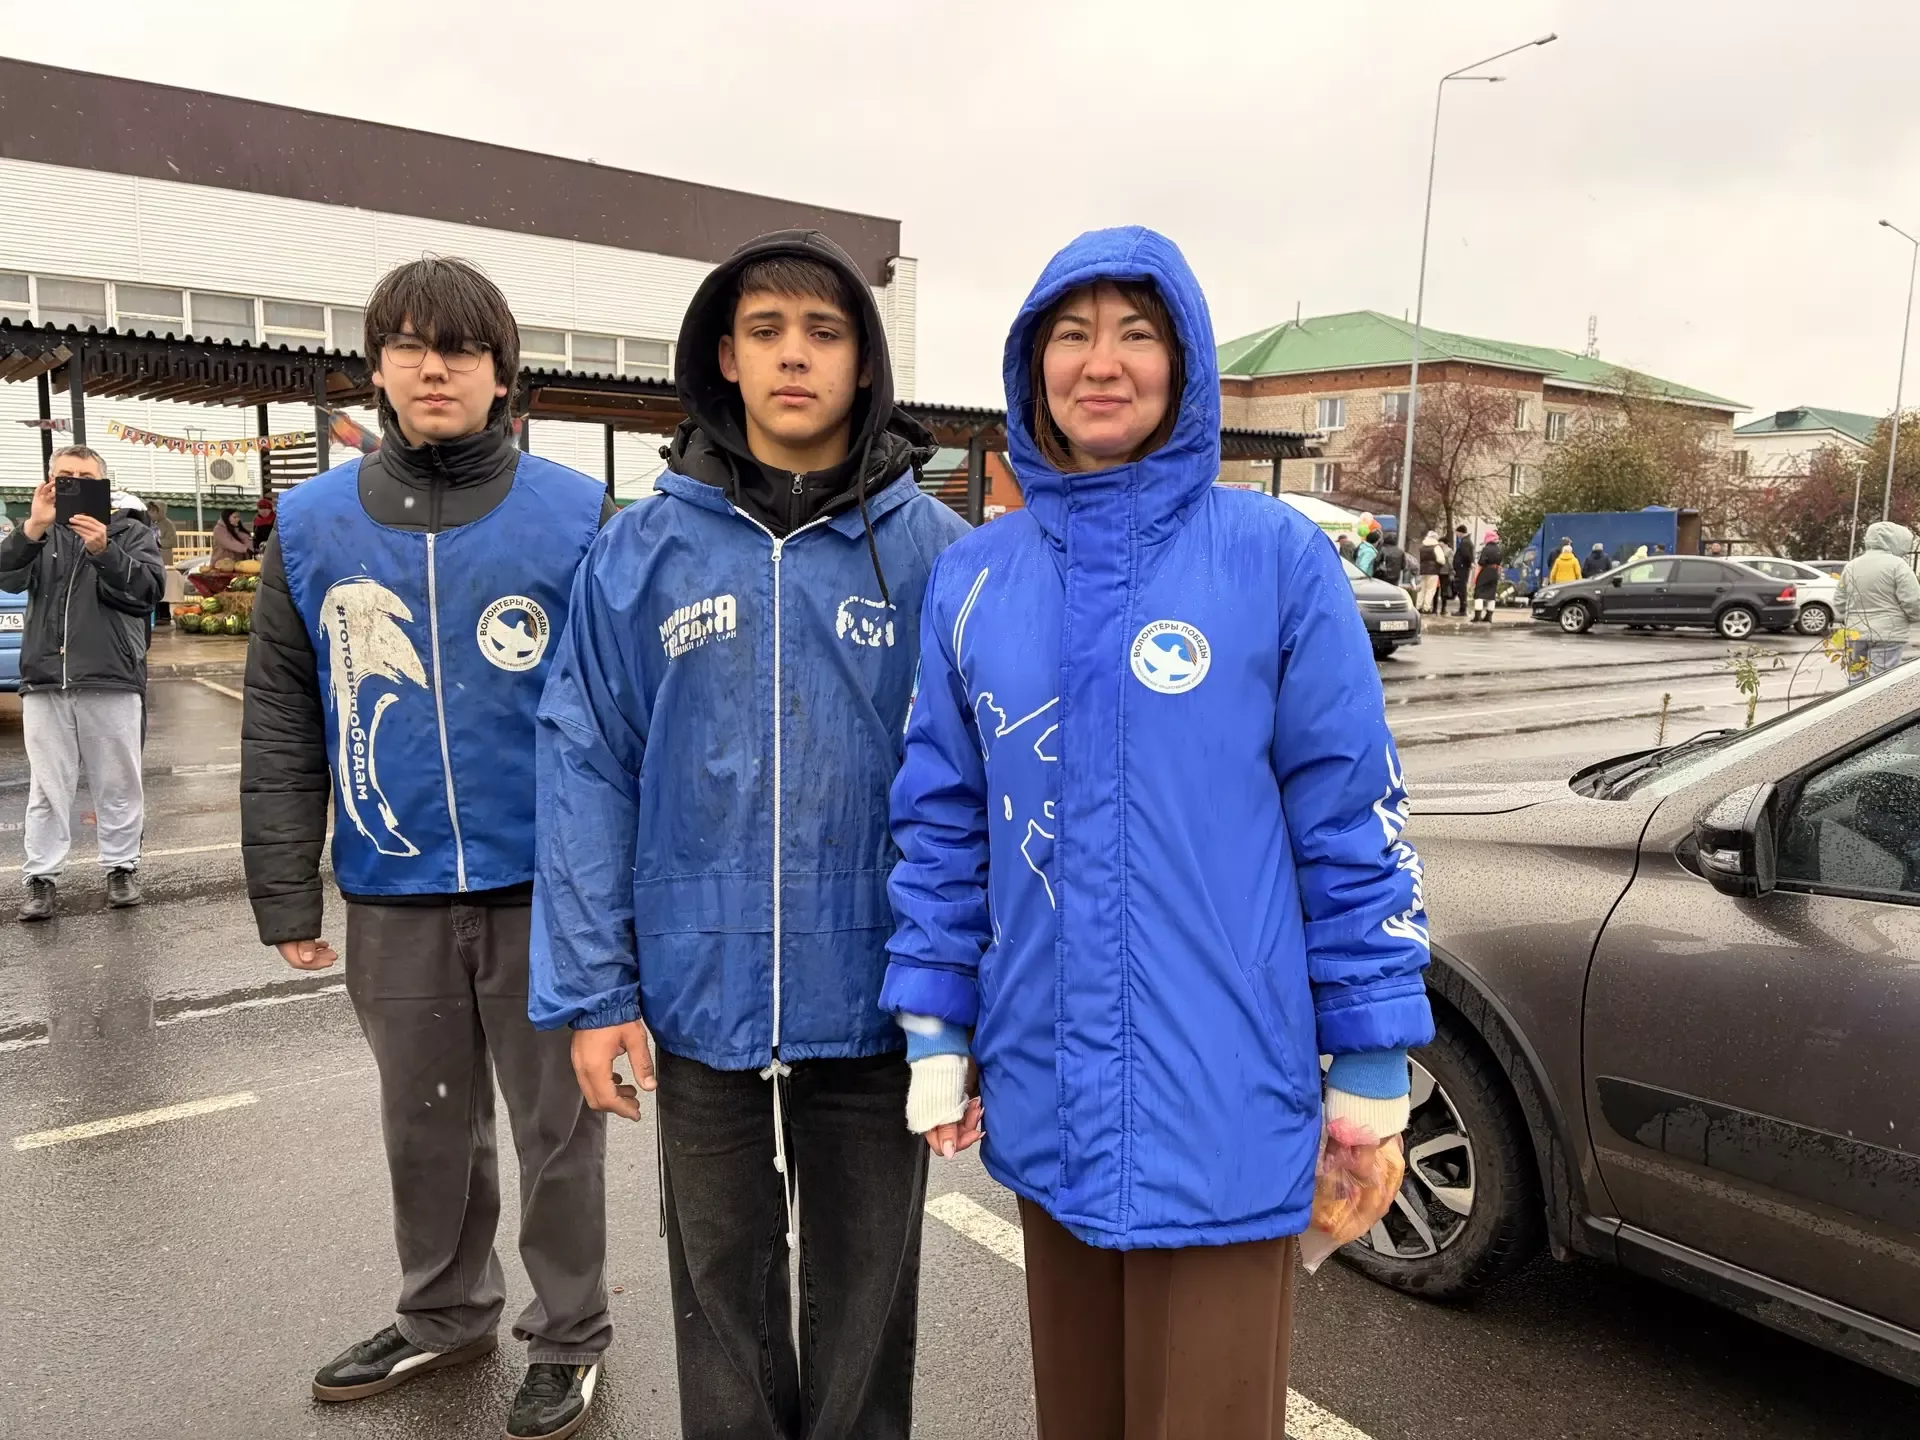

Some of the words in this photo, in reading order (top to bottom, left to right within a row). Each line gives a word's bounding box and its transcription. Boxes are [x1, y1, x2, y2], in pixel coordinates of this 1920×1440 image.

[480, 599, 524, 636] ВОЛОНТЕРЫ
[526, 602, 547, 635] ПОБЕДЫ
[1133, 623, 1179, 658] ВОЛОНТЕРЫ
[1181, 626, 1208, 659] ПОБЕДЫ
